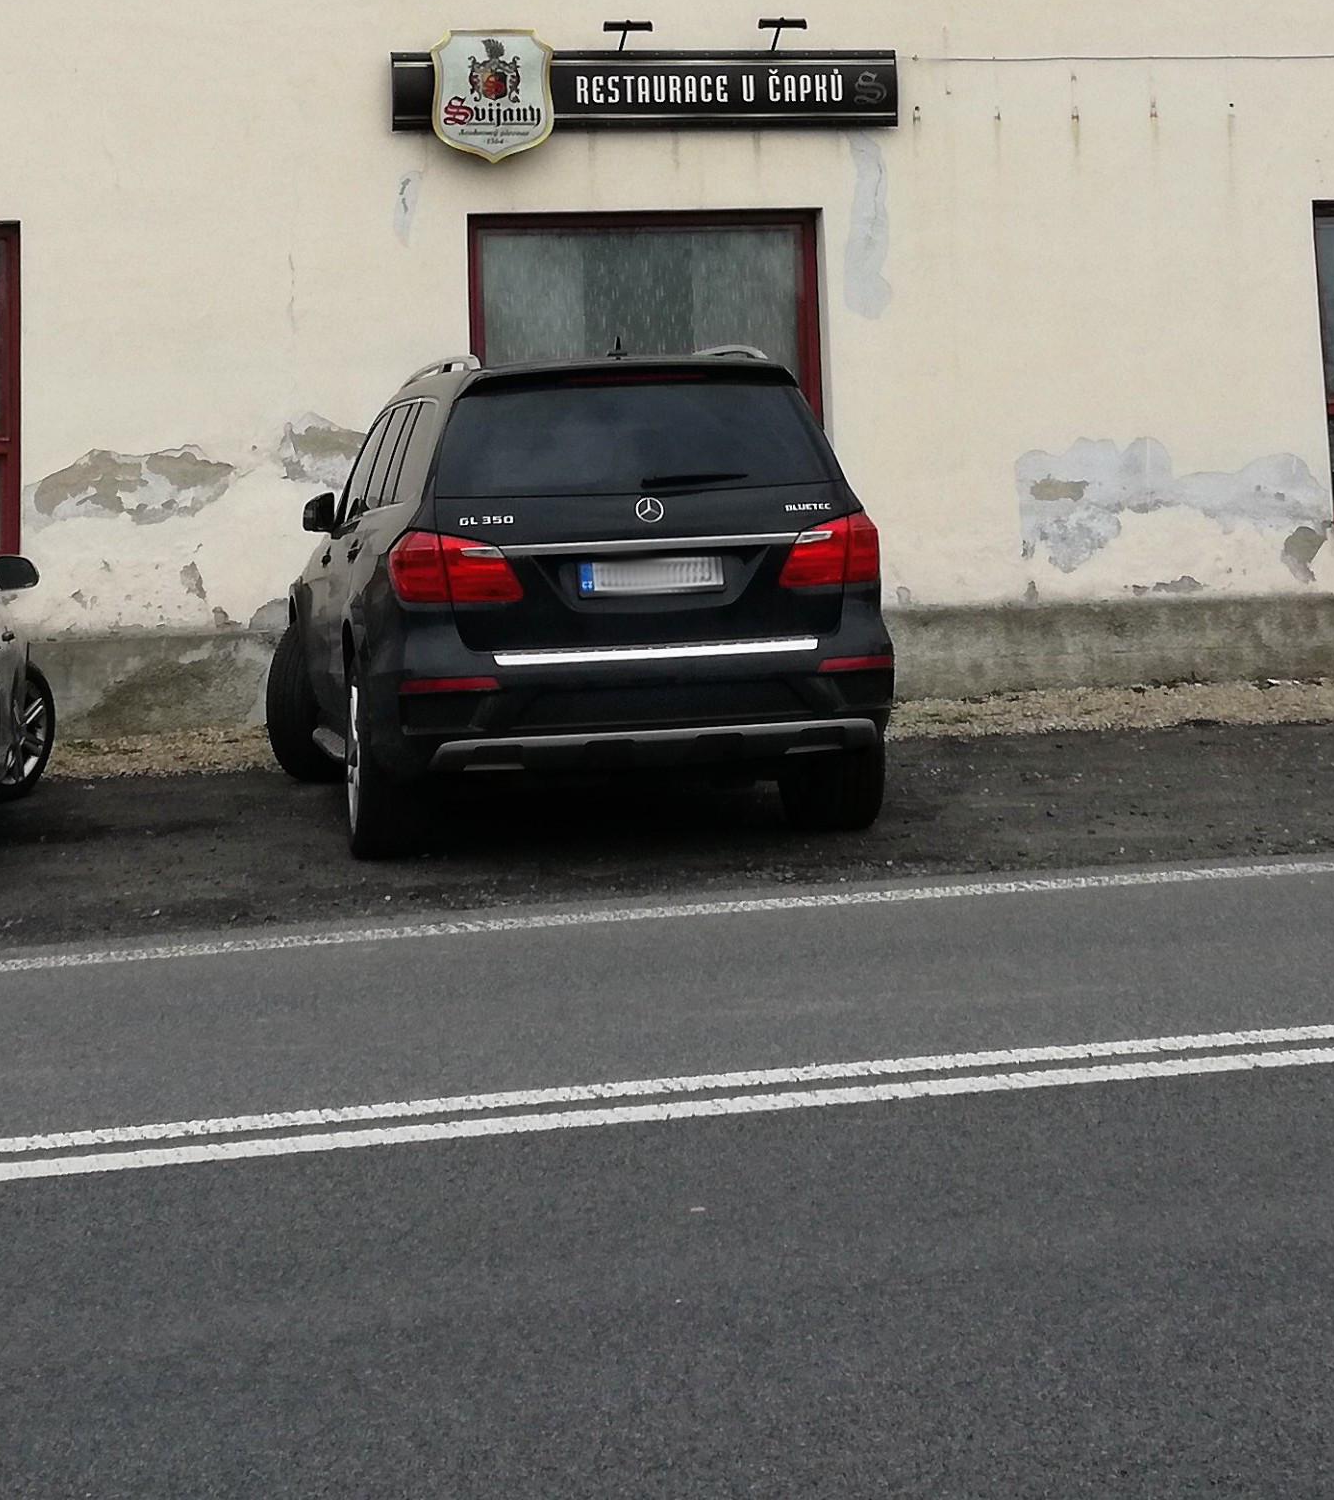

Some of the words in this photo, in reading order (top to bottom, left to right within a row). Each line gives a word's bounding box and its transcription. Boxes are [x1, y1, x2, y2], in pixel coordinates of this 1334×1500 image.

[576, 75, 728, 105] RESTAURACE
[741, 74, 755, 103] U
[768, 68, 844, 103] ČAPKŮ
[443, 96, 541, 128] Svijany
[459, 516, 478, 526] GL
[482, 515, 514, 525] 350
